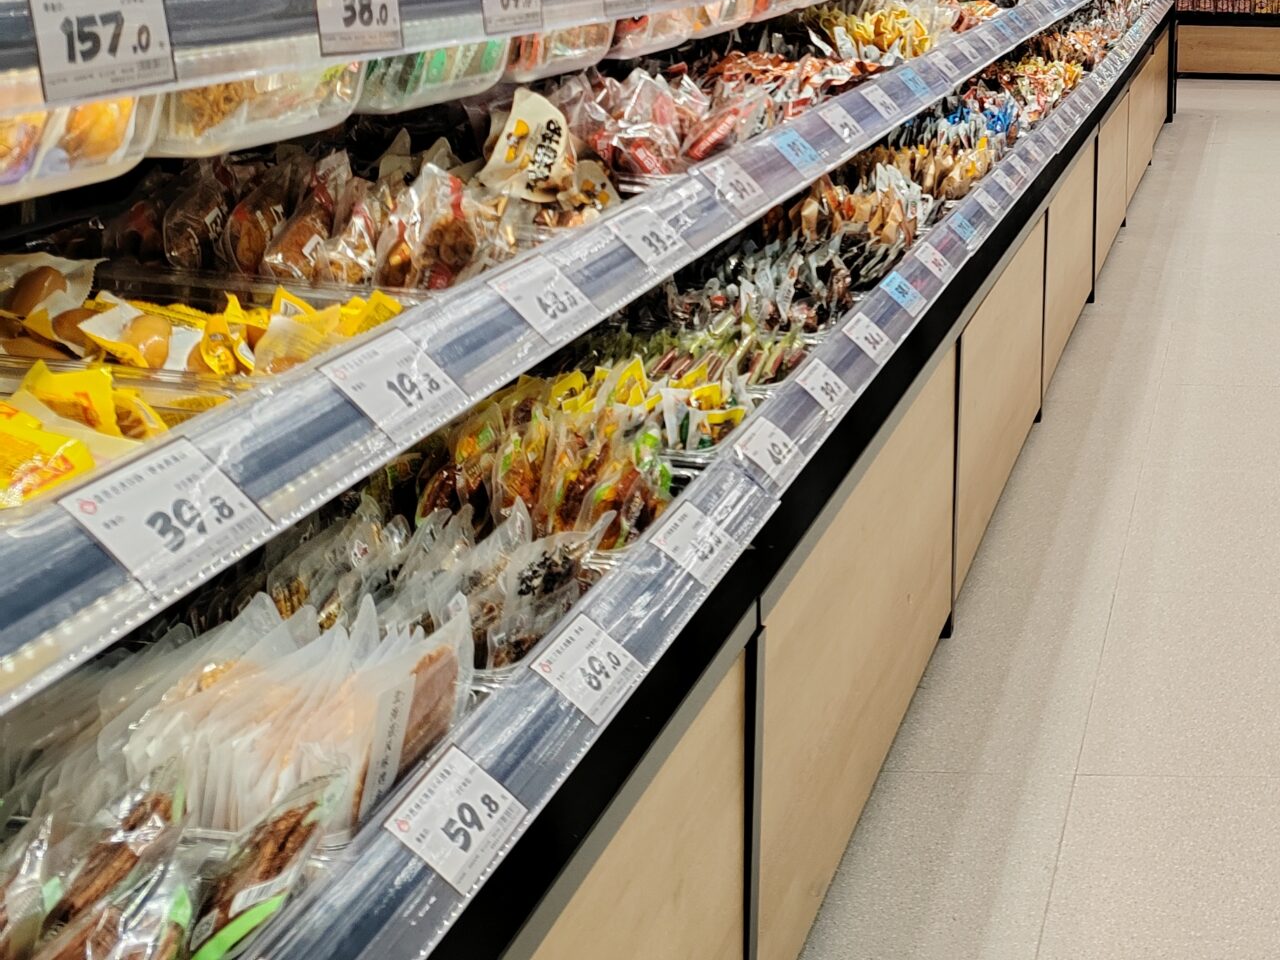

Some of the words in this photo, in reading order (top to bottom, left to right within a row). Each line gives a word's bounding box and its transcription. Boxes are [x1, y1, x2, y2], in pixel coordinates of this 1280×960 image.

[60, 10, 152, 64] 157.0
[385, 370, 440, 408] 19.8
[145, 495, 235, 554] 39.8
[578, 651, 622, 692] 69.0
[441, 793, 500, 853] 59.8
